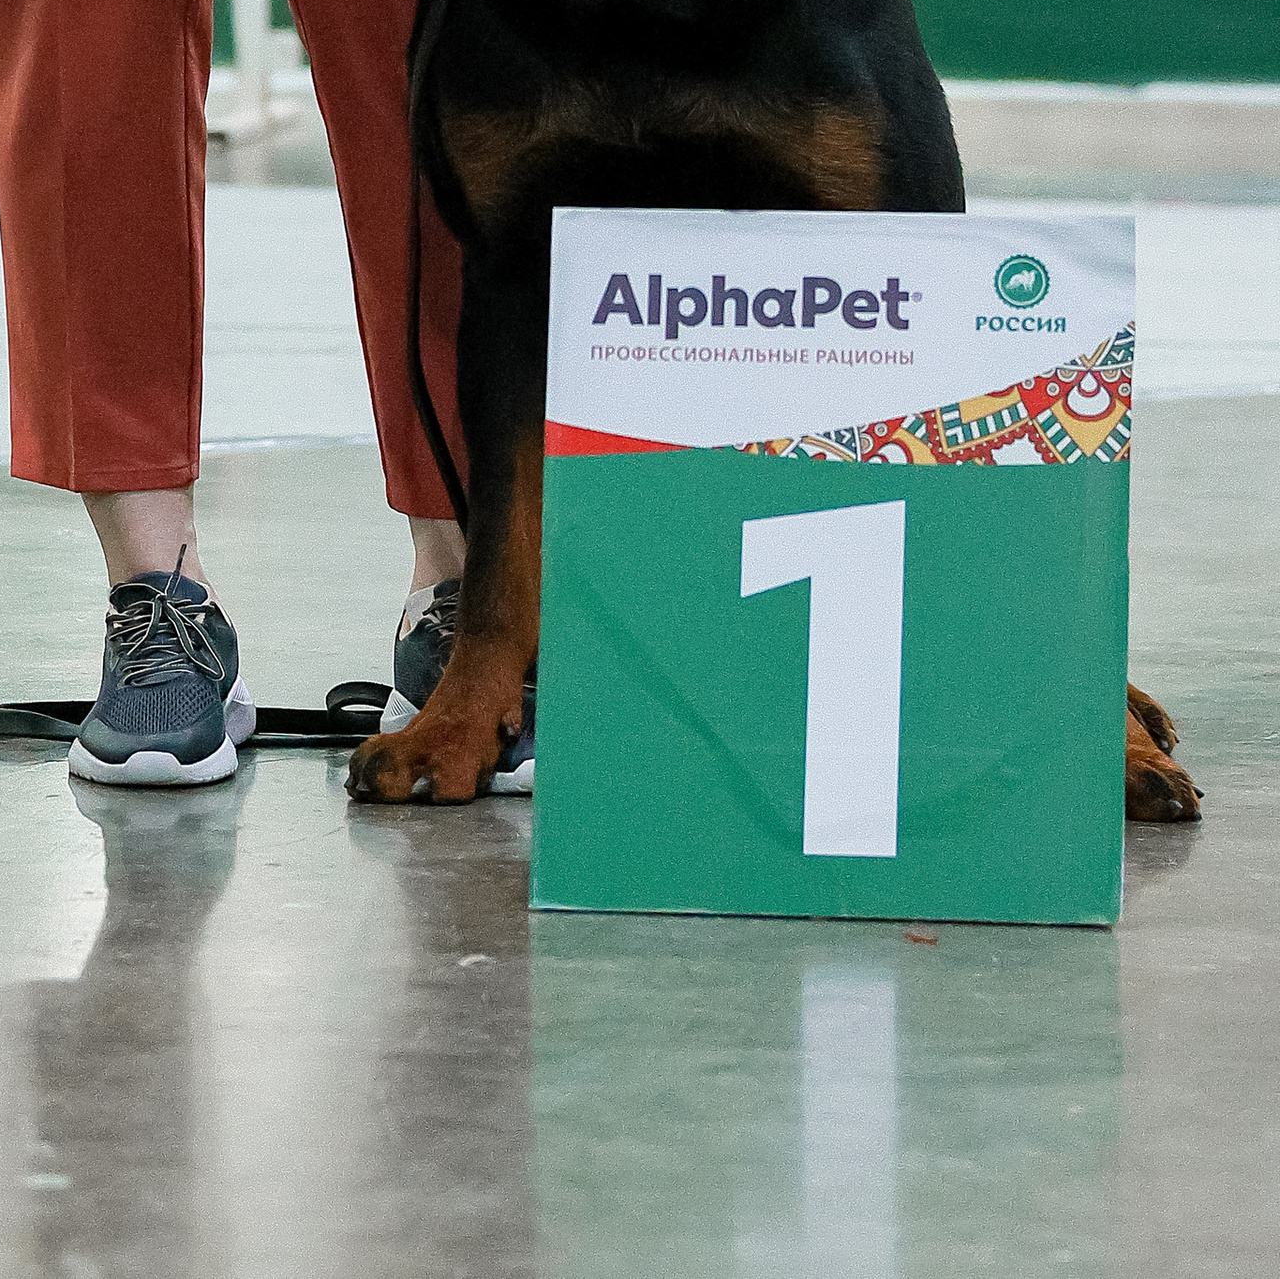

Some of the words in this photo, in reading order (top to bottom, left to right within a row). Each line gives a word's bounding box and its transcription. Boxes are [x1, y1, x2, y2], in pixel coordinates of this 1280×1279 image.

[592, 273, 910, 340] AlphaPet
[975, 315, 1067, 333] РОССИЯ
[589, 344, 810, 365] ПРОФЕССИОНАЛЬНЫЕ
[815, 347, 915, 368] РАЦИОНЫ
[740, 499, 907, 859] 1
